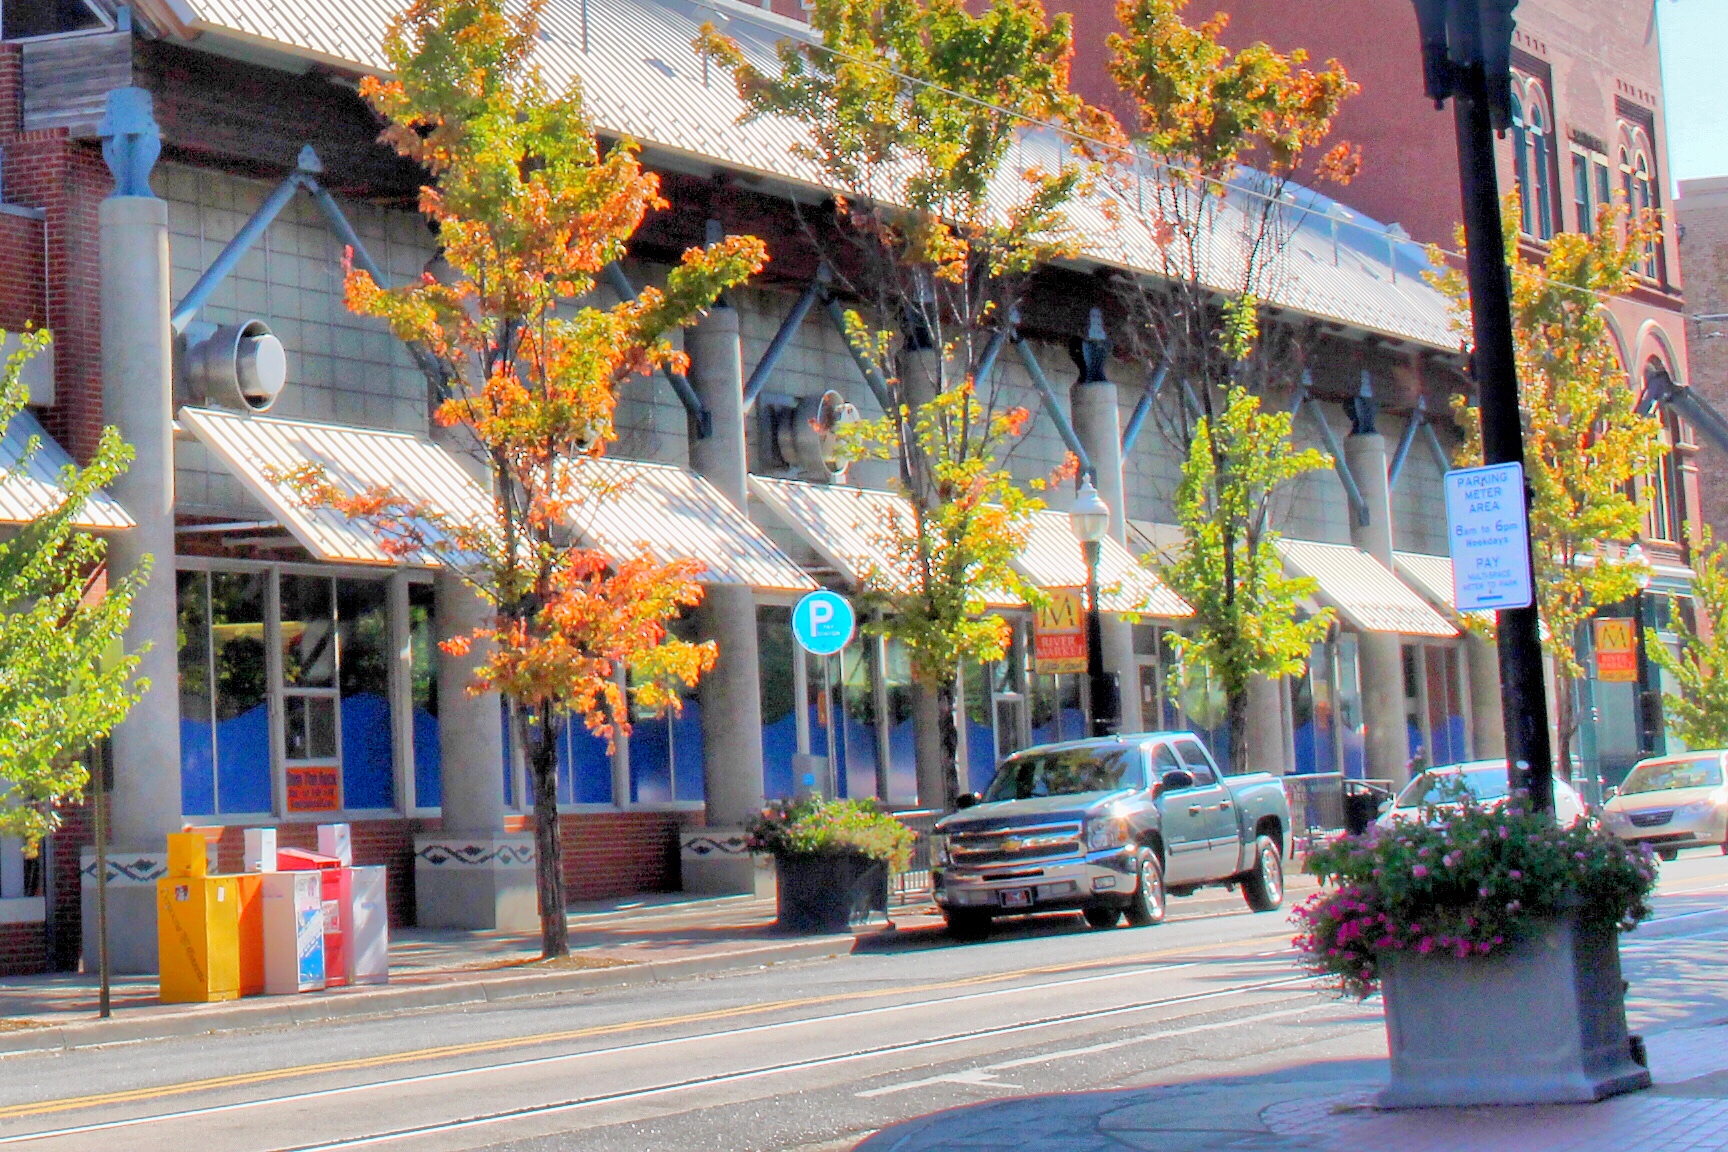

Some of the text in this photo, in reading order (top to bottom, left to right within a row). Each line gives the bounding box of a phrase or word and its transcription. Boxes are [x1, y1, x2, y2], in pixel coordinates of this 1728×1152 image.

[1457, 472, 1507, 488] PARKING
[1464, 487, 1501, 500] METER
[1469, 501, 1500, 513] AREA
[1455, 525, 1477, 536] 8am
[1495, 520, 1518, 533] 6pm
[1476, 556, 1499, 568] PAY
[809, 599, 834, 638] P
